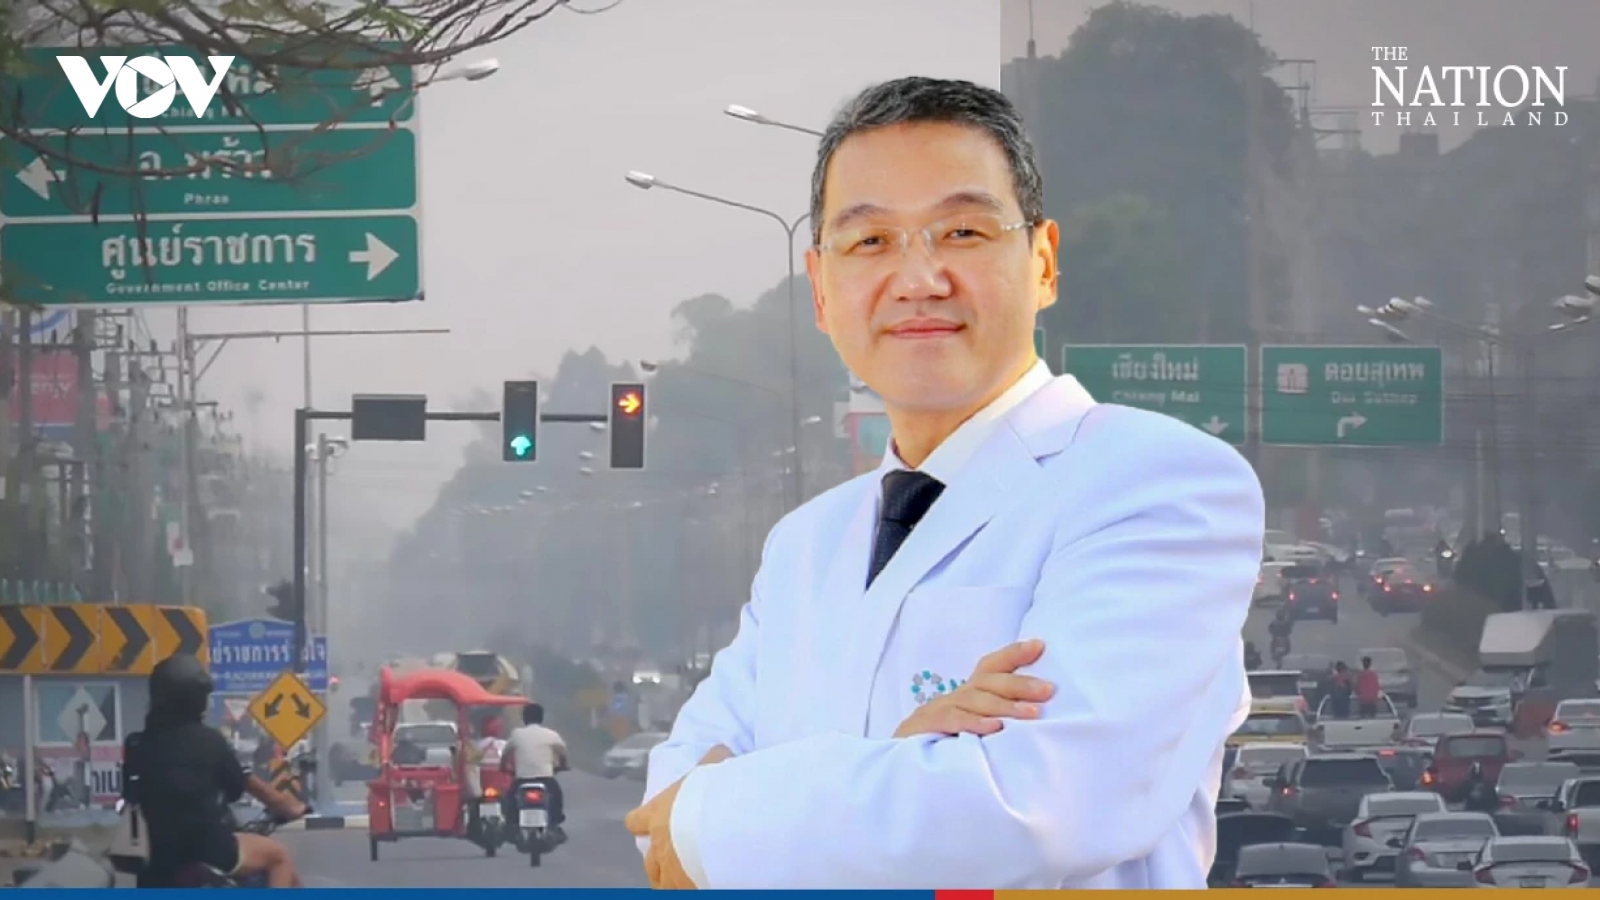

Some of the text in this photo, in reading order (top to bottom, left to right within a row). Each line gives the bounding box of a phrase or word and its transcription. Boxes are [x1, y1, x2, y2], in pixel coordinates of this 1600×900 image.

[102, 223, 316, 280] ศูนย์ราชการ
[105, 278, 310, 295] Government Office Center
